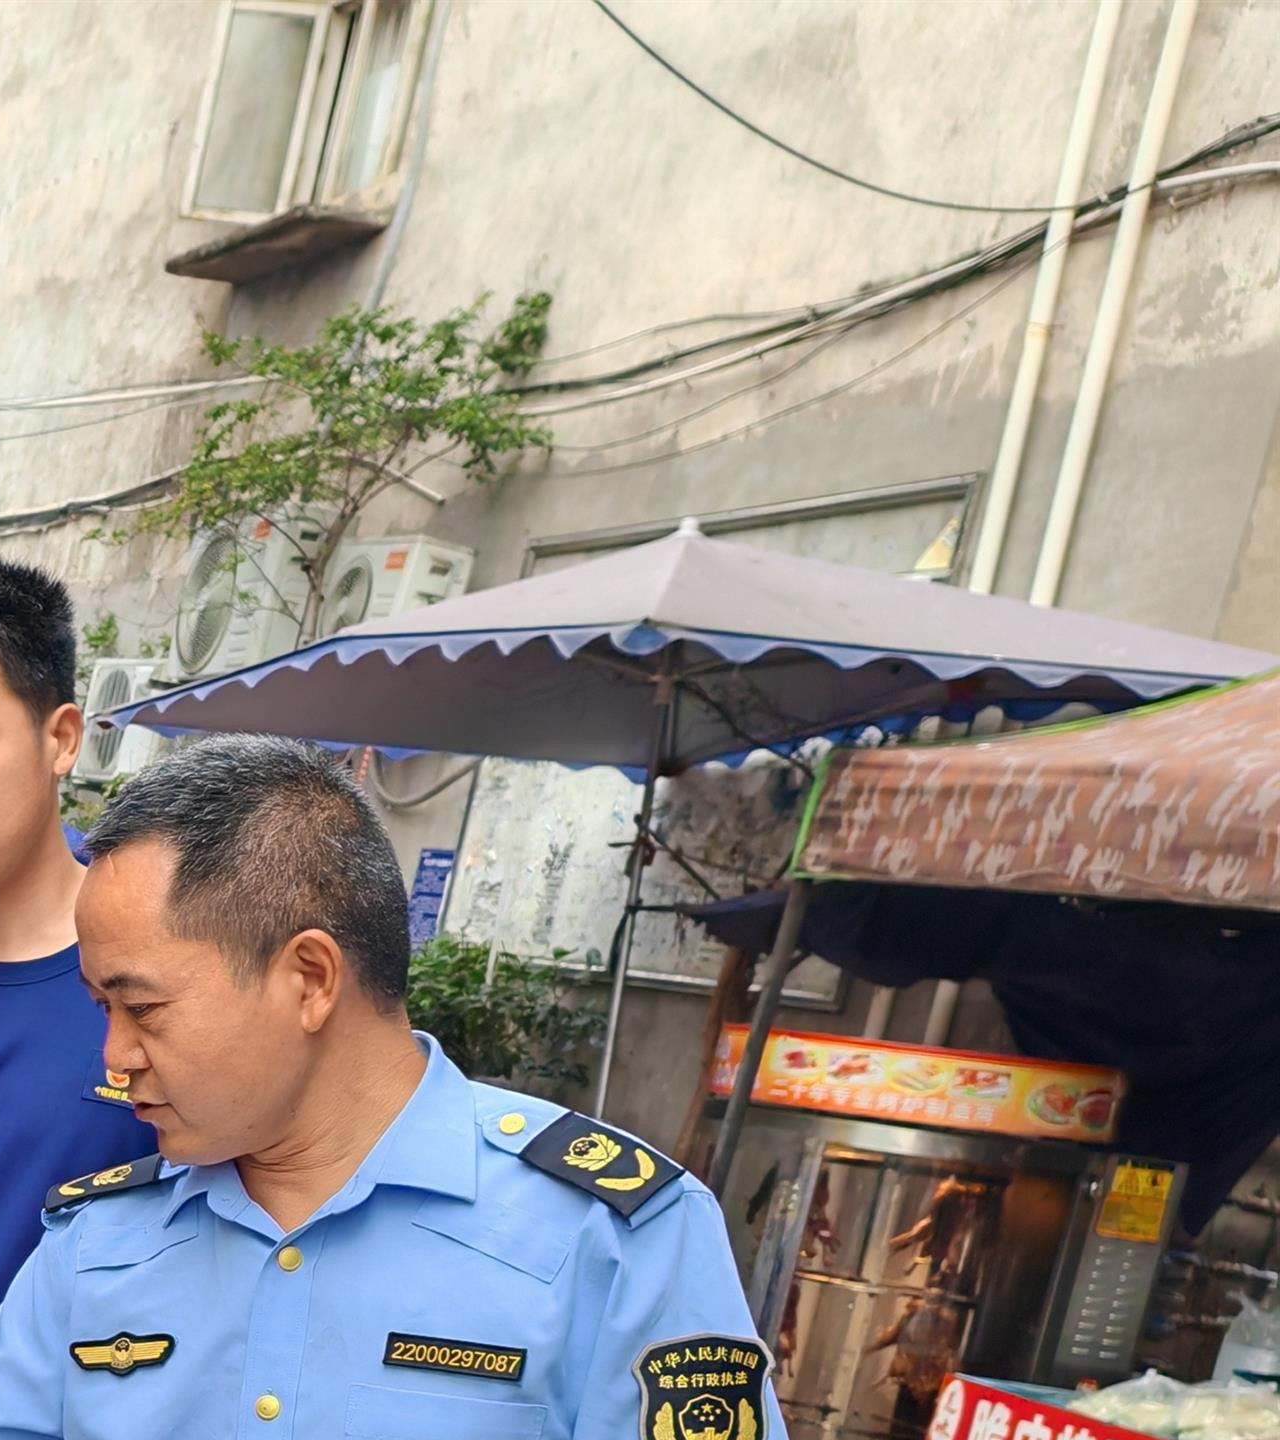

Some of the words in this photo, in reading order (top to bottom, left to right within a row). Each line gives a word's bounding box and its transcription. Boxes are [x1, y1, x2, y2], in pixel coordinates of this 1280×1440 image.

[391, 1342, 521, 1373] 22000297087
[647, 1346, 759, 1375] 中华人民共和国
[658, 1371, 748, 1389] 综合行政执法
